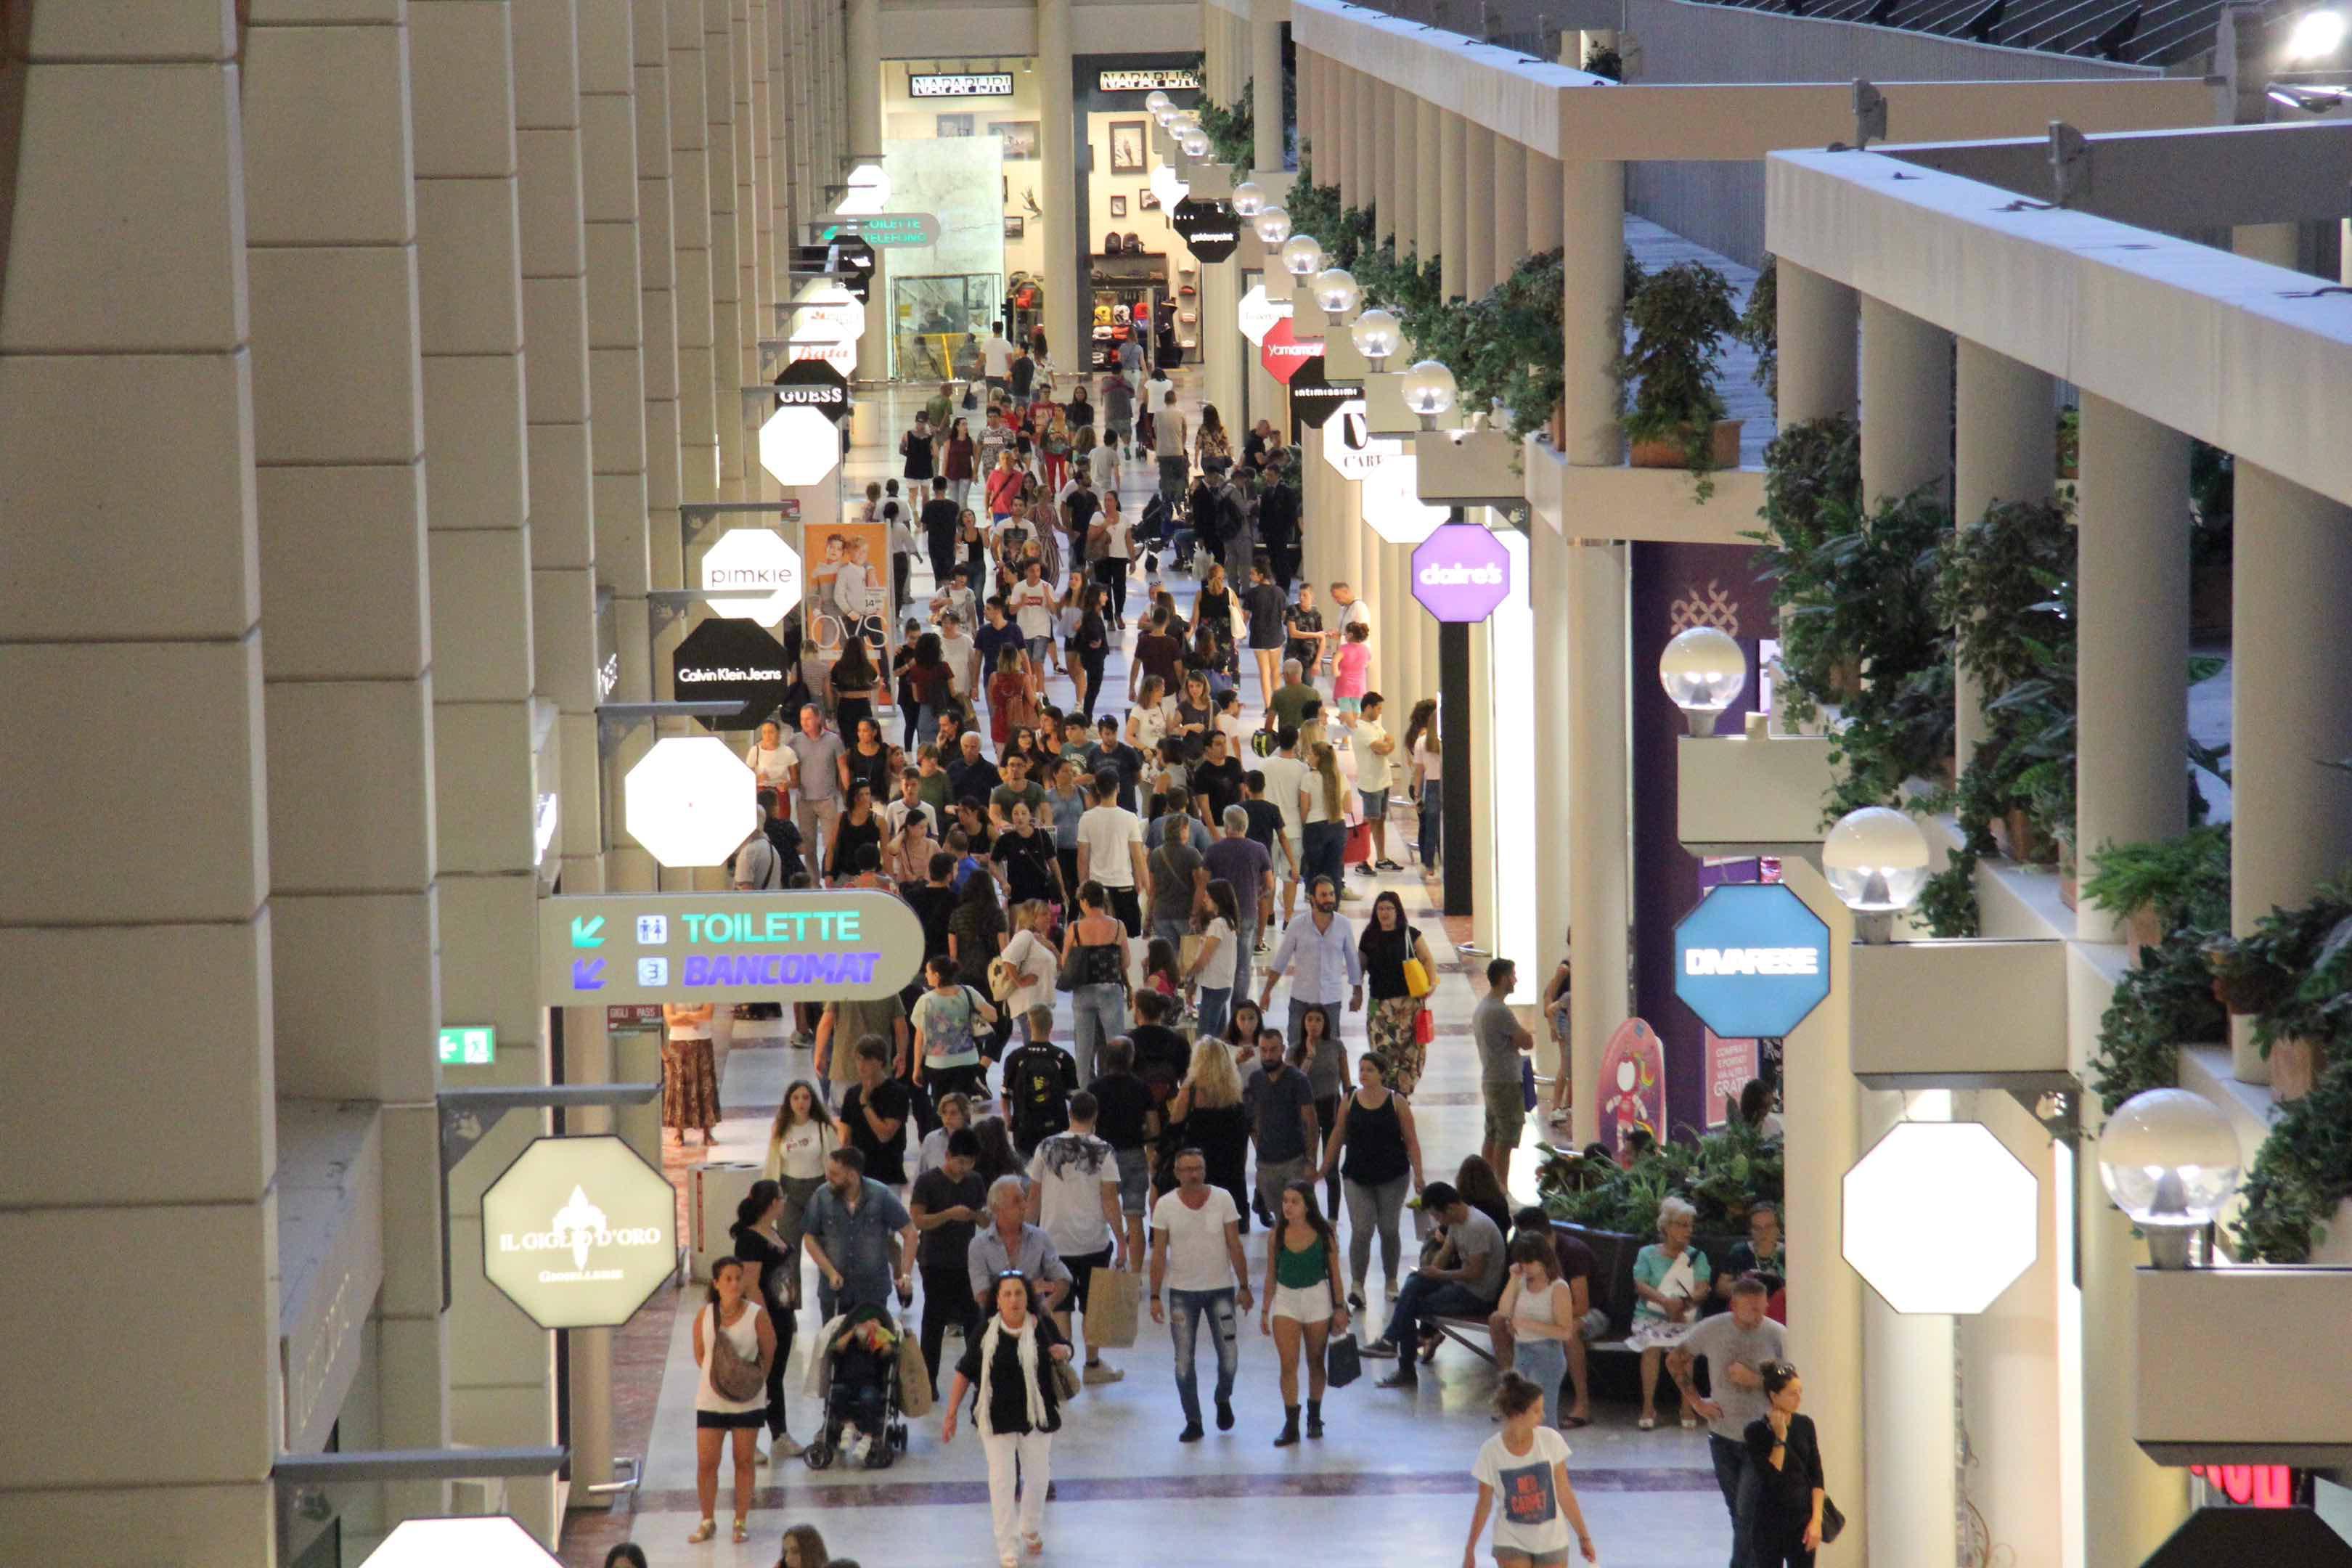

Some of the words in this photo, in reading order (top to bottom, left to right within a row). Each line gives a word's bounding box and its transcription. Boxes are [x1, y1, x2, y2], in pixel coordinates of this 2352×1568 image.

[914, 77, 1011, 94] NAPAPIJRI
[1103, 71, 1199, 89] NAPAPIJR
[1190, 232, 1234, 243] goldenpoint
[778, 388, 843, 403] GUESS
[1294, 387, 1357, 397] intimissimi
[1419, 562, 1503, 586] claire's
[812, 615, 889, 648] OVS
[679, 668, 717, 682] Calvin
[718, 667, 746, 682] Klein
[746, 667, 782, 681] Jeans
[682, 911, 862, 944] TOILETTE
[683, 952, 881, 986] BANCOMAT
[1686, 948, 1818, 976] DIVARESE
[499, 1233, 520, 1251] IL
[522, 1230, 593, 1249] GIGLO
[597, 1228, 662, 1247] D'ORO
